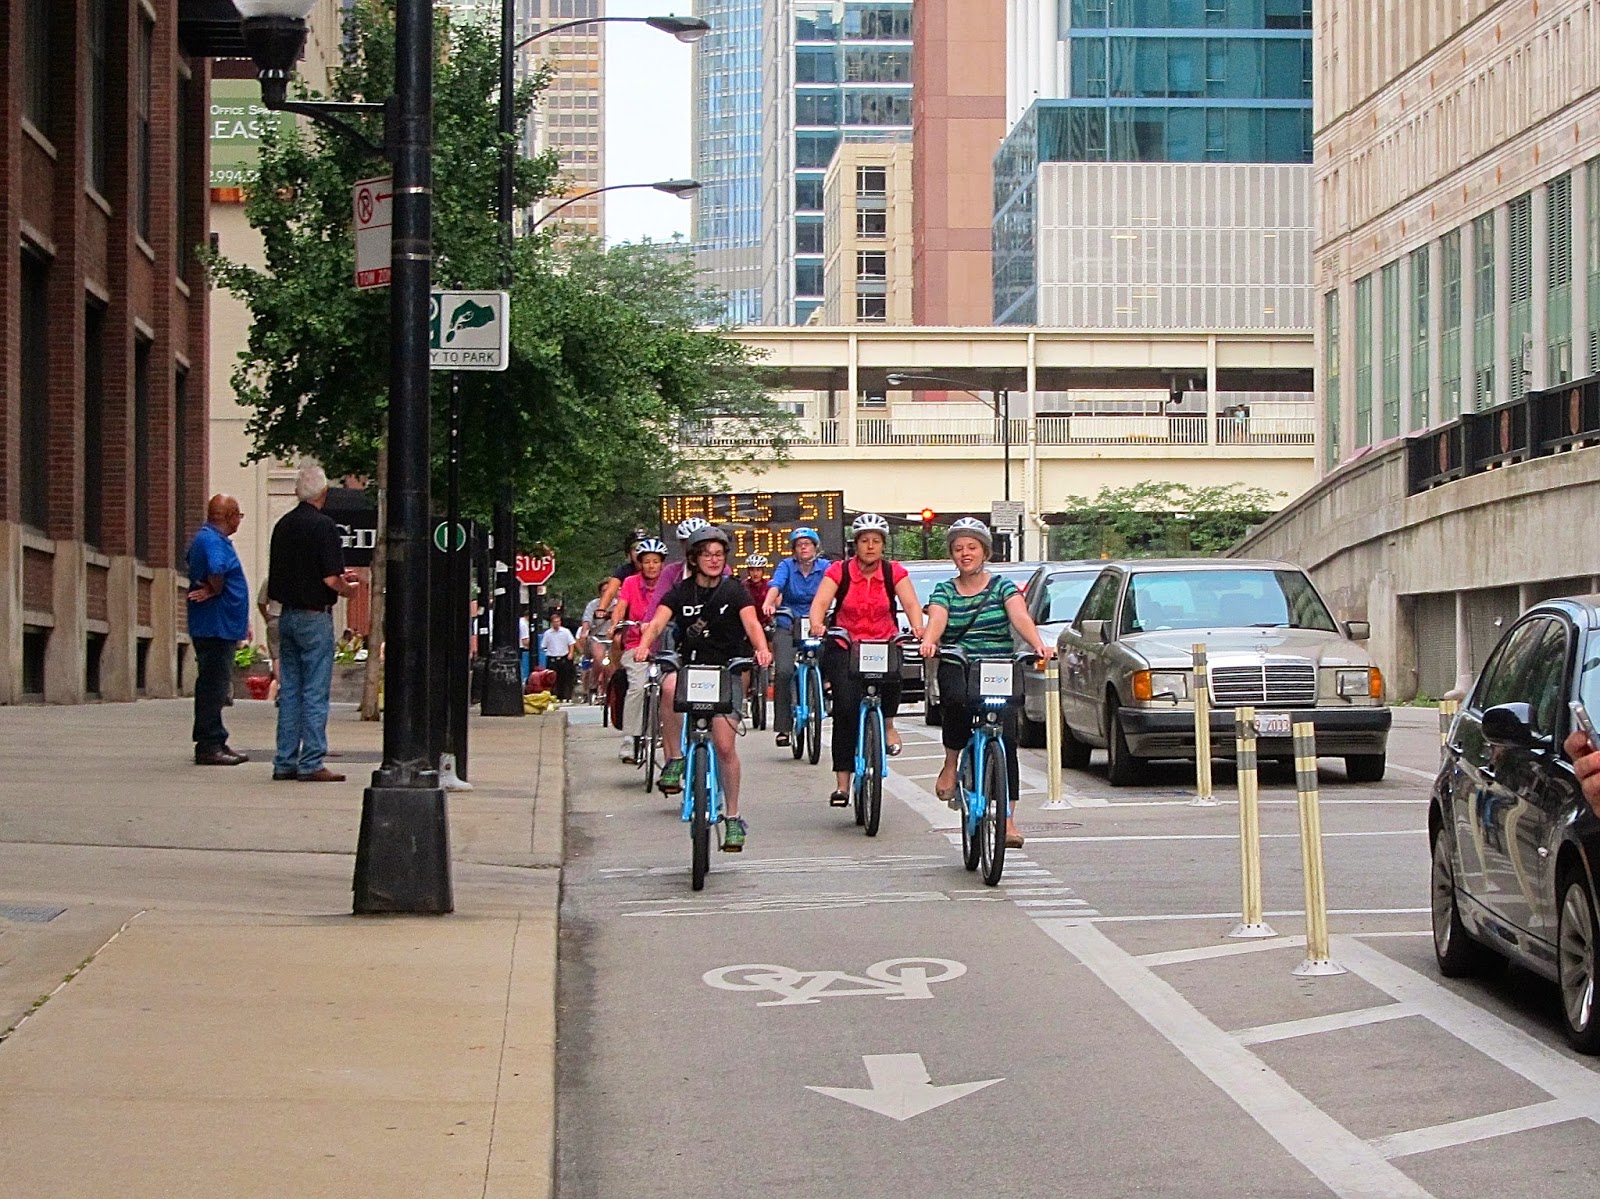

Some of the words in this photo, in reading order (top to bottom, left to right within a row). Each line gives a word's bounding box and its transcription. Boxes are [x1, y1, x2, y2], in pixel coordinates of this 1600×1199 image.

[209, 120, 281, 139] EASE
[443, 352, 459, 362] TO
[463, 352, 495, 363] PARK
[662, 494, 773, 525] WELLS
[798, 492, 841, 520] ST
[515, 555, 551, 571] STOP
